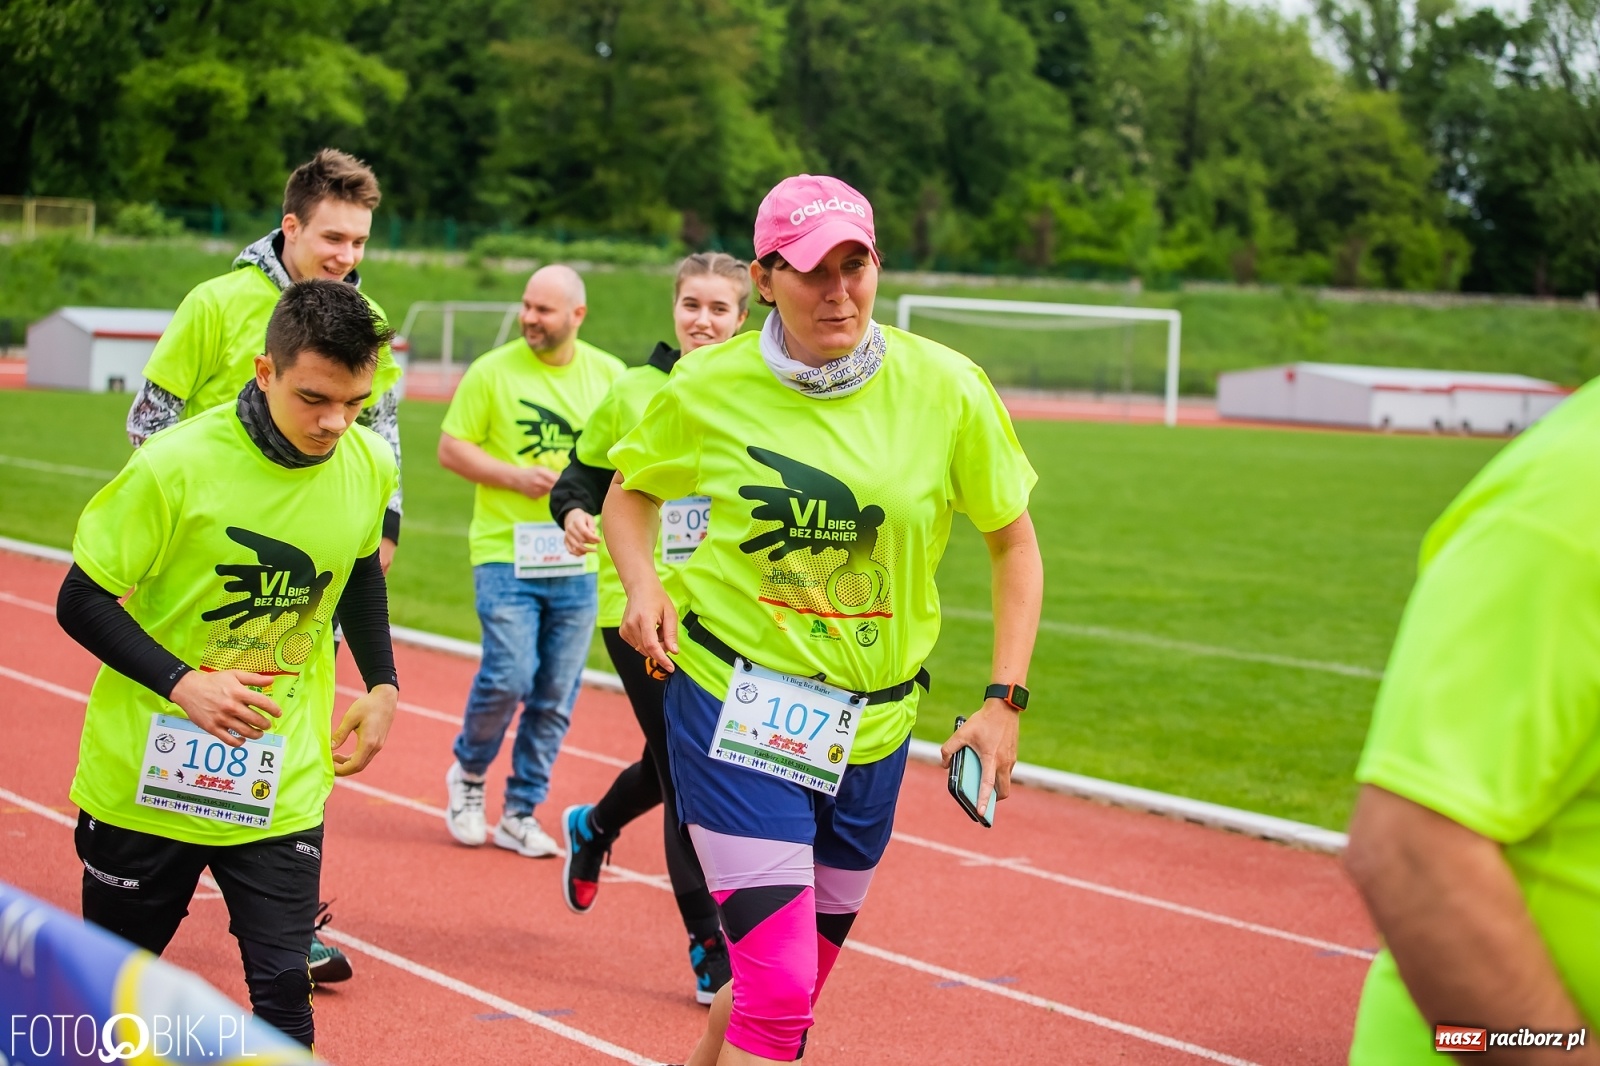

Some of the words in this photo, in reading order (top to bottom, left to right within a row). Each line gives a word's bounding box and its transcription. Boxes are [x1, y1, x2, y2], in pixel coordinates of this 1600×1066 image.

[789, 196, 866, 226] adidas
[687, 508, 711, 530] 09
[789, 497, 827, 528] VI
[827, 519, 856, 530] BIEG
[789, 528, 812, 539] BEZ
[814, 530, 858, 542] BARIER
[260, 571, 291, 596] VI
[287, 586, 311, 597] BIEG
[253, 597, 273, 607] BEZ
[762, 697, 830, 741] 107
[838, 709, 852, 729] R
[182, 738, 249, 778] 108
[260, 750, 275, 768] R
